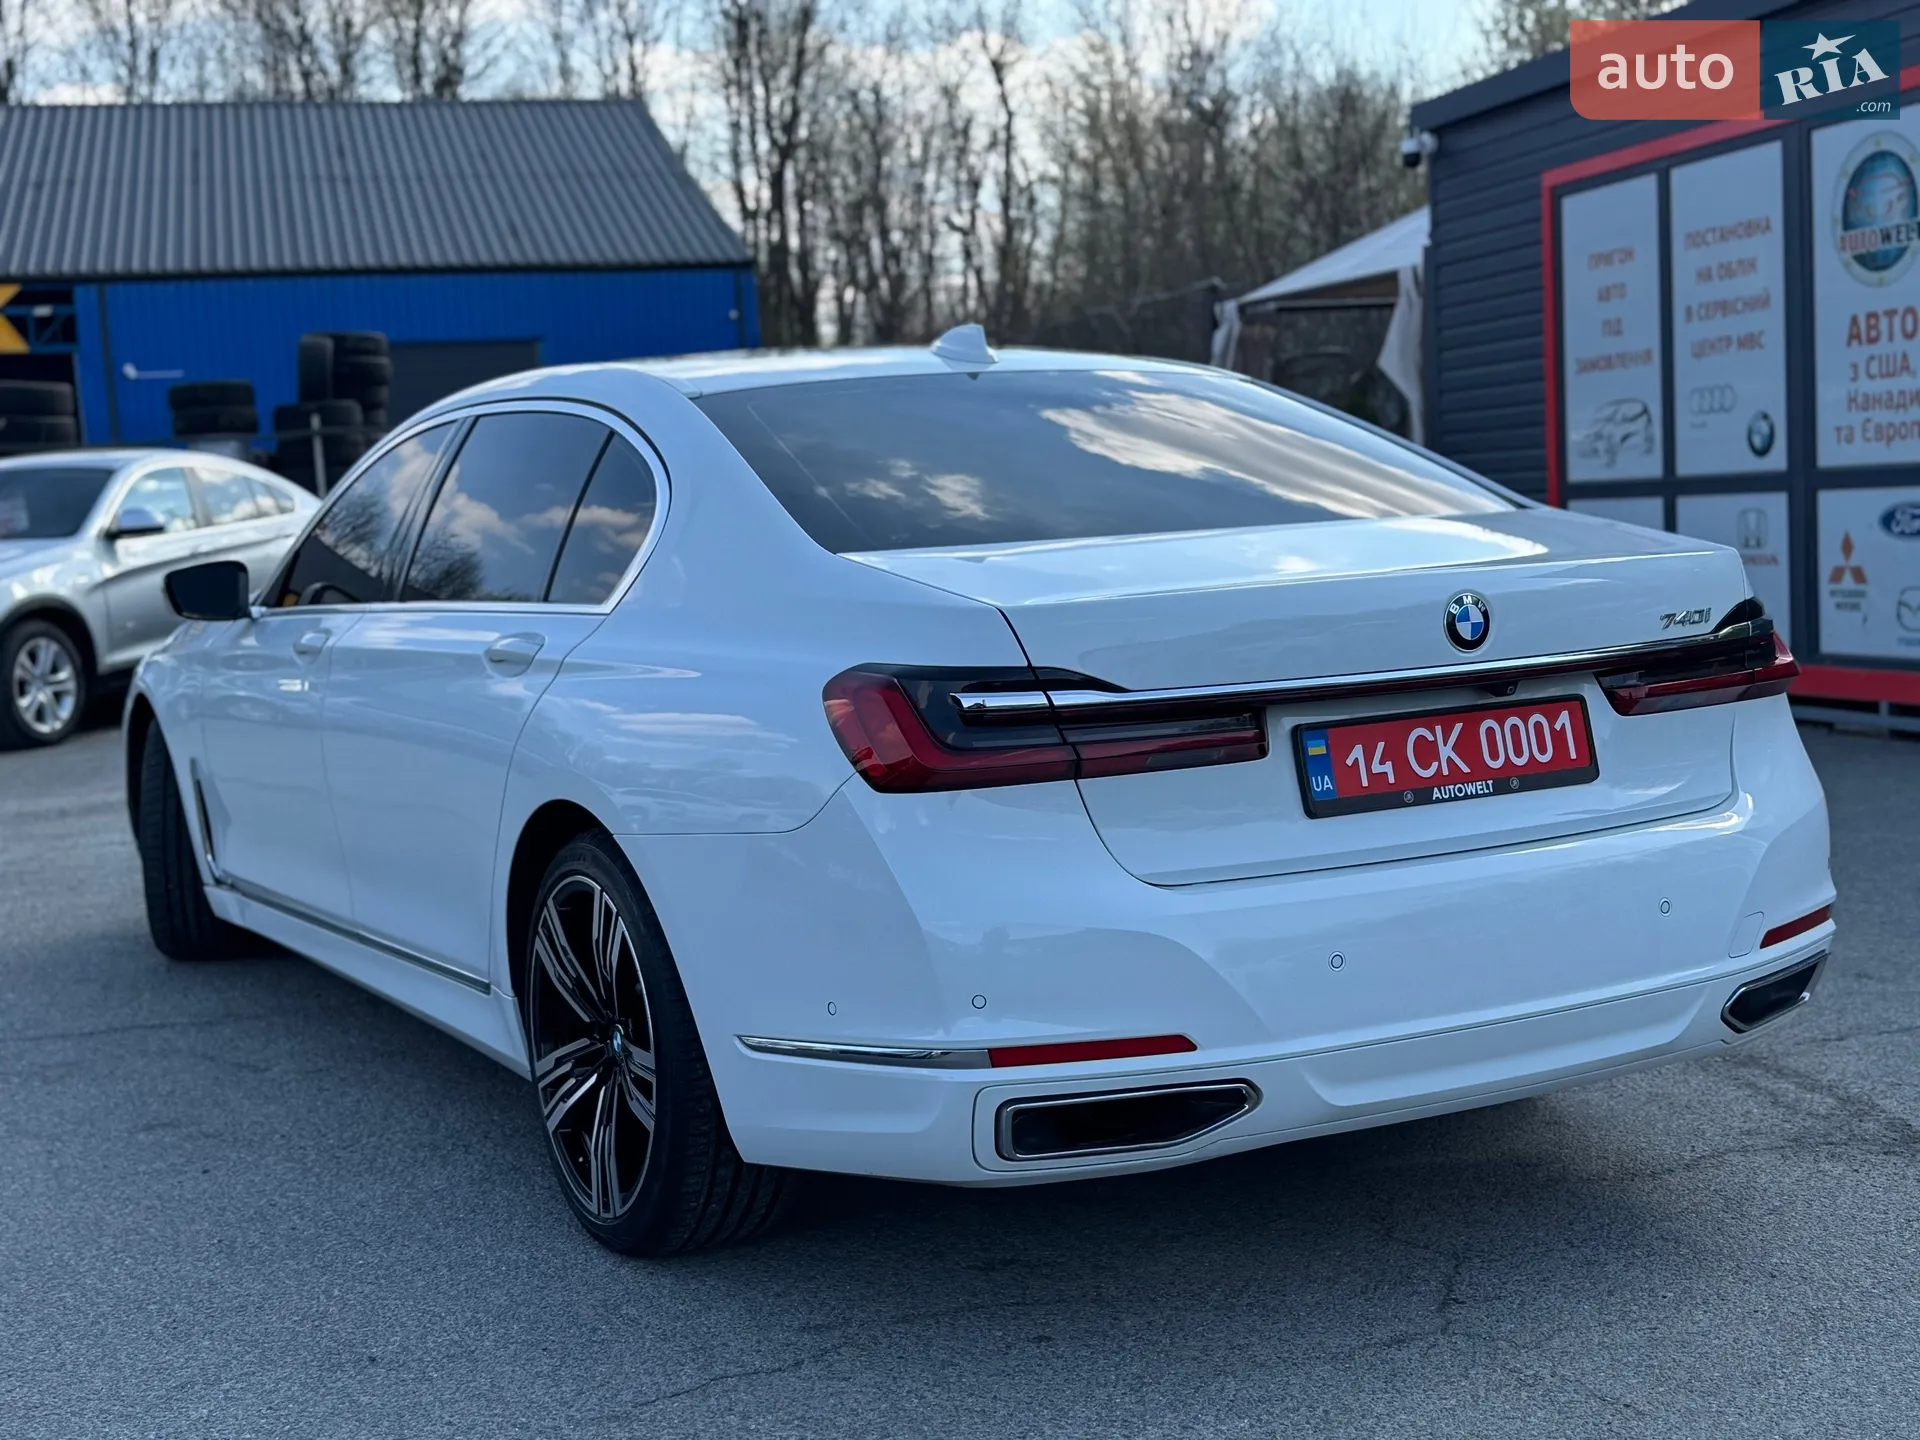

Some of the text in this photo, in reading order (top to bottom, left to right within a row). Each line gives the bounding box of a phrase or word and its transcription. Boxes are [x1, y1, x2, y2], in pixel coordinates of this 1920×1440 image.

[1684, 216, 1772, 250] ПОСТАНОВКА
[1846, 305, 1919, 348] АВТО
[1835, 424, 1854, 445] та
[1345, 710, 1577, 787] 14 CK 0001
[1312, 774, 1334, 792] UA
[1432, 780, 1494, 800] AUTOWELT
